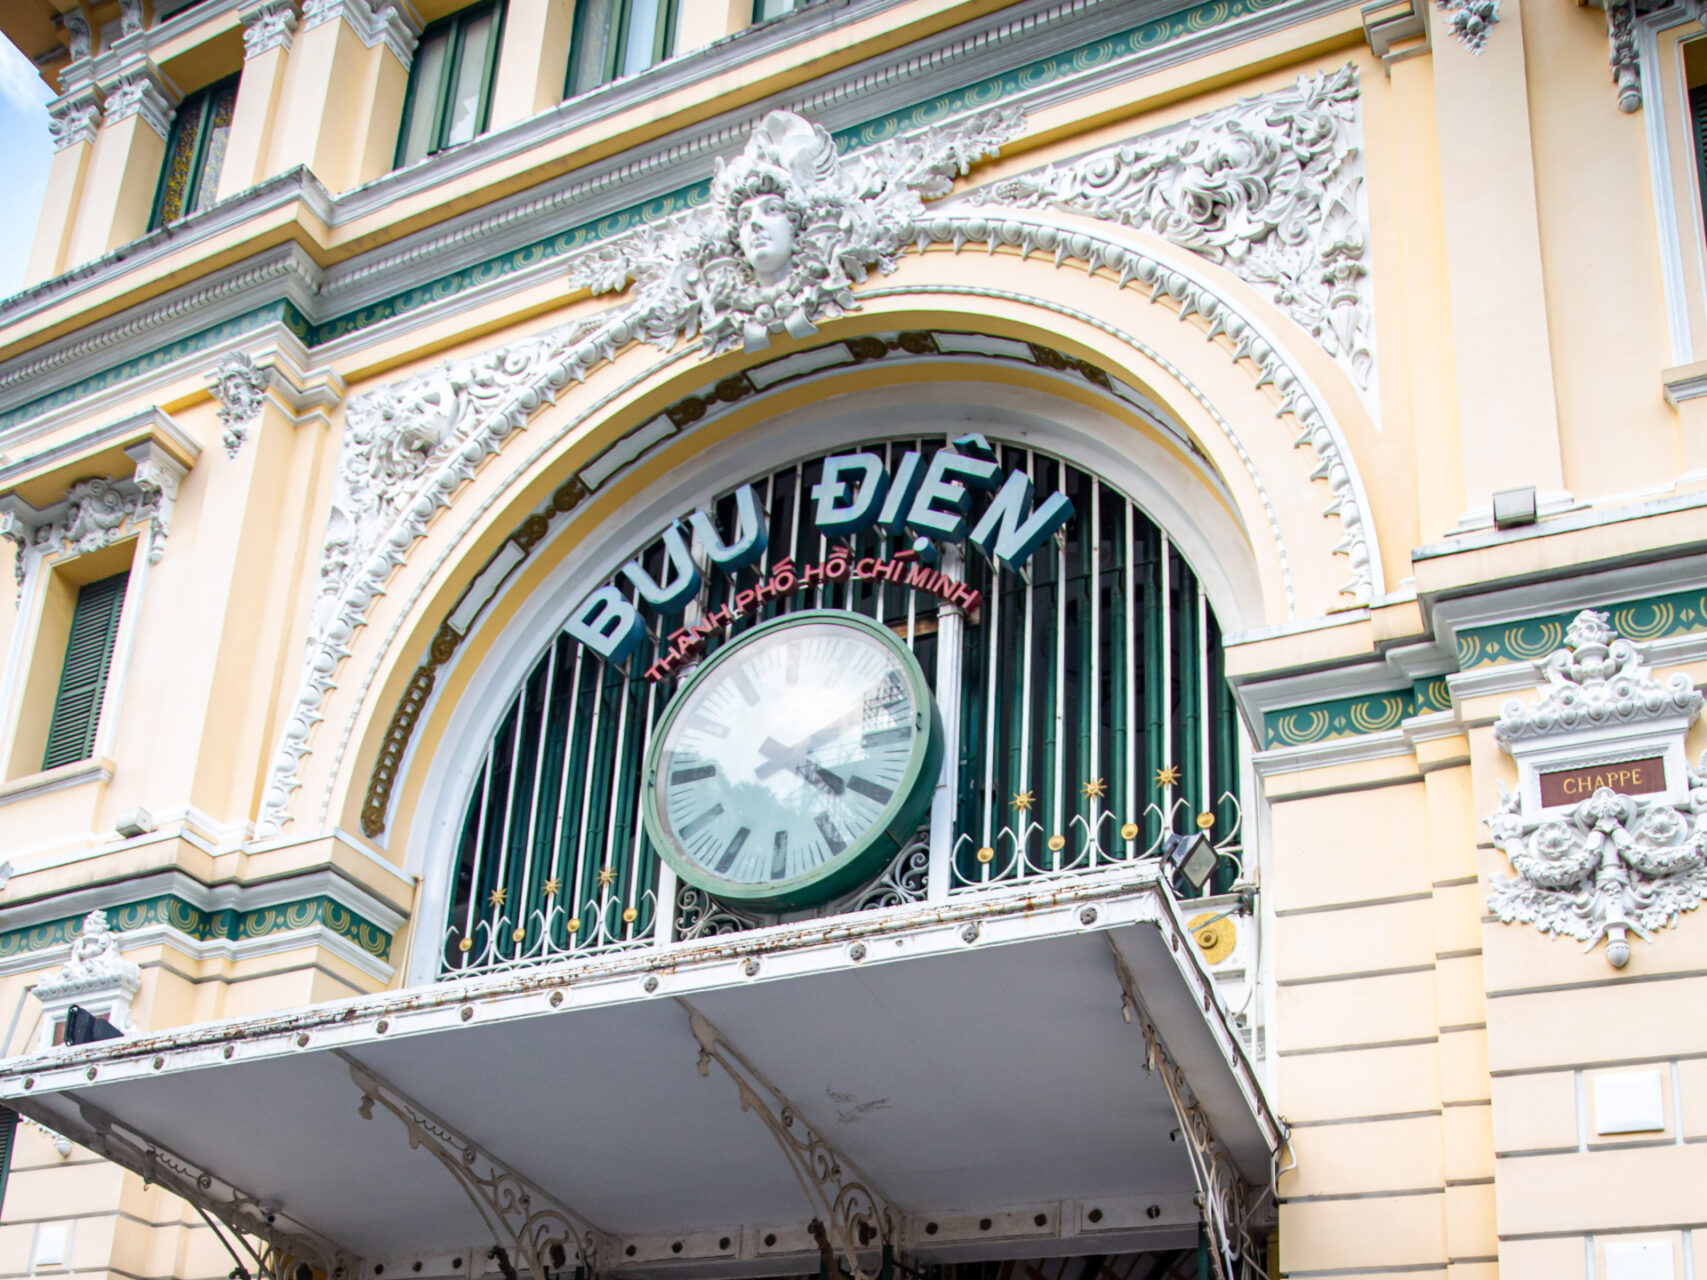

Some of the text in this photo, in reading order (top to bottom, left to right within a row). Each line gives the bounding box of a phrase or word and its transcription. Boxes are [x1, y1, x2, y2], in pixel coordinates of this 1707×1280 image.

[564, 433, 1073, 661] BƯU ĐIỆN
[644, 545, 982, 684] THÀNH PHỐ HỒ CHÍ MINH
[1563, 768, 1643, 794] CHAPPE
